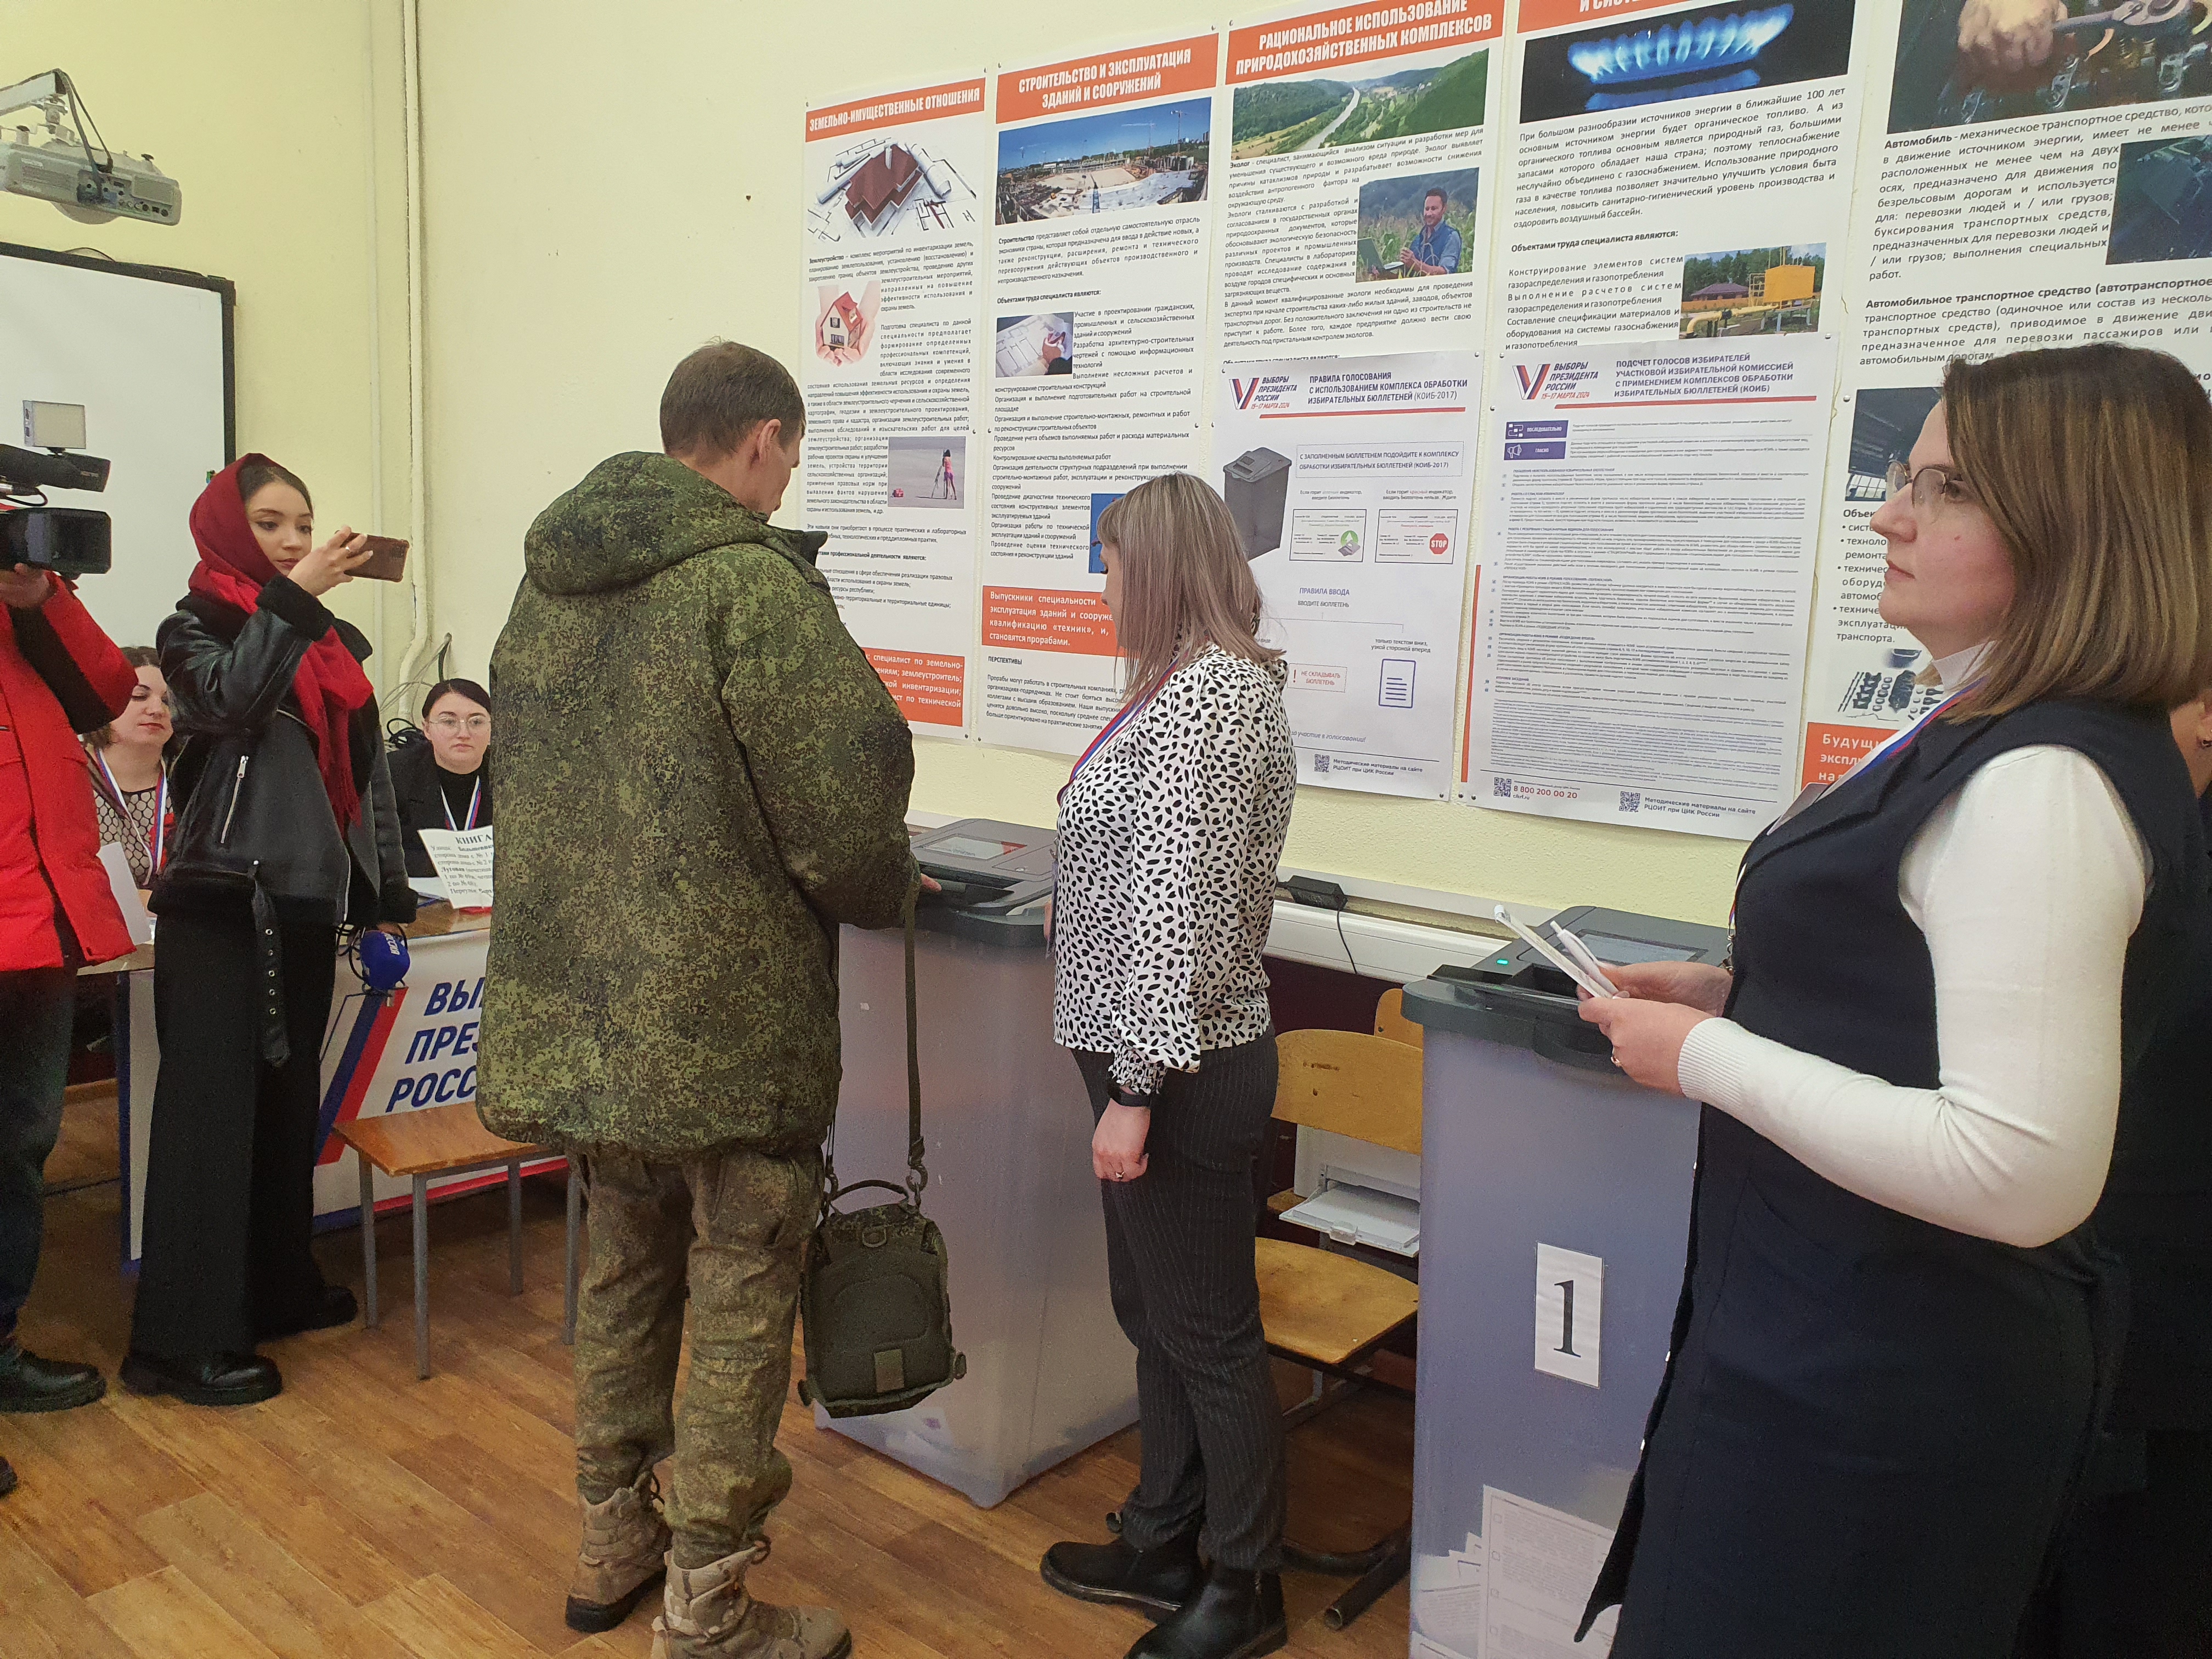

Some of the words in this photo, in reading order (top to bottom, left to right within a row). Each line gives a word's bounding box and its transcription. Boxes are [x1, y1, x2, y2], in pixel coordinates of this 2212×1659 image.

[1259, 17, 1352, 50] РАЦИОНАЛЬНОЕ
[1355, 0, 1468, 31] ИСПОЛЬЗОВАНИЕ
[1235, 31, 1398, 75] ПРИРОДОХОЗЯЙСТВЕННЫХ
[1400, 13, 1492, 46] КОМПЛЕКСОВ
[1019, 65, 1097, 93] СТРОИТЕЛЬСТВО
[1099, 63, 1107, 78] И
[1108, 48, 1191, 77] ЭКСПЛУАТАЦИЯ
[1042, 86, 1082, 110] ЗДАНИЙ
[1084, 86, 1091, 101] И
[1092, 73, 1161, 100] СООРУЖЕНИЙ
[809, 97, 924, 132] ЗЕМЕЛЬНО-ИМУЩЕСТВЕННЫЕ
[925, 88, 980, 110] ОТНОШЕНИЯ
[1520, 133, 1535, 143] При
[1538, 127, 1575, 139] большом
[1578, 118, 1637, 134] разнообразии
[1640, 110, 1691, 123] источников
[1695, 105, 1732, 116] энергии
[1746, 94, 1802, 109] ближайшие
[1807, 89, 1825, 100] 100
[1827, 88, 1846, 97] лет
[1519, 143, 1559, 154] основным
[1565, 134, 1614, 147] источником
[1621, 128, 1655, 140] энергии
[1662, 124, 1688, 134] будет
[1694, 115, 1759, 130] органическое
[1767, 108, 1809, 120] топливо.
[1816, 103, 1824, 112] А
[1832, 102, 1843, 110] из
[1516, 179, 1562, 191] неслучайно
[1565, 173, 1615, 185] объединено
[1626, 162, 1701, 178] газоснабжением.
[1705, 153, 1776, 168] Использование
[1780, 145, 1838, 160] природного
[1875, 213, 1898, 224] для:
[1905, 207, 1962, 221] перевозки
[1968, 203, 2006, 213] людей
[2041, 198, 2063, 207] или
[2071, 190, 2116, 206] грузов;
[1511, 242, 1556, 252] Объектами
[1557, 240, 1580, 250] труда
[1581, 235, 1634, 246] специалиста
[1634, 230, 1679, 241] являются:
[1908, 253, 1946, 264] грузов;
[1953, 246, 2022, 259] выполнения
[2029, 238, 2109, 253] специальных
[1869, 269, 1901, 282] работ.
[1866, 296, 1953, 308] Автомобильное
[1955, 290, 2035, 304] транспортное
[2038, 286, 2091, 299] средство
[1553, 361, 1589, 371] ВЫБОРЫ
[1616, 359, 1651, 368] ПОДСЧЕТ
[1653, 357, 1690, 366] ГОЛОСОВ
[1692, 354, 1751, 364] ИЗБИРАТЕЛЕЙ
[1549, 371, 1599, 381] ПРЕЗИДЕНТА
[1616, 366, 1667, 377] УЧАСТКОВОЙ
[1668, 365, 1737, 375] ИЗБИРАТЕЛЬНОЙ
[1739, 363, 1793, 372] КОМИССИЕЙ
[1261, 375, 1290, 384] ВЫБОРЫ
[1310, 375, 1341, 383] ПРАВИЛА
[1342, 372, 1392, 382] ГОЛОСОВАНИЯ
[1622, 377, 1682, 387] ПРИМЕНЕНИЕМ
[1683, 375, 1740, 385] КОМПЛЕКСОВ
[1742, 373, 1793, 382] ОБРАБОТКИ
[1258, 384, 1297, 393] ПРЕЗИДЕНТА
[1315, 383, 1379, 394] ИСПОЛЬЗОВАНИЕМ
[1380, 381, 1422, 391] КОМПЛЕКСА
[1424, 379, 1468, 388] ОБРАБОТКИ
[1544, 382, 1577, 391] РОССИИ
[1614, 388, 1682, 397] ИЗБИРАТЕЛЬНЫХ
[1684, 384, 1739, 394] БЮЛЛЕТЕНЕЙ
[1740, 385, 1770, 394] (КОИБ)
[1308, 395, 1365, 405] ИЗБИРАТЕЛЬНЫХ
[1367, 392, 1413, 402] БЮЛЛЕТЕНЕЙ
[1414, 391, 1457, 402] (КОИБ-2017)
[1431, 540, 1447, 548] STOP
[1842, 578, 1885, 588] оборуд
[990, 591, 1033, 602] Выпускники
[1038, 596, 1096, 606] специальности
[1329, 588, 1350, 596] ВВОДА
[990, 606, 1036, 617] эксплуатация
[1040, 608, 1067, 618] зданий
[990, 619, 1047, 631] квалификацию
[1053, 624, 1094, 635] «техник»,
[1101, 628, 1109, 636] и,
[989, 633, 1026, 642] становятся
[1026, 635, 1070, 646] прорабами.
[1837, 633, 1895, 643] транспорта.
[873, 654, 911, 664] специалист
[927, 659, 963, 669] земельно-
[988, 656, 1022, 665] ПЕРСПЕКТИВЫ
[902, 683, 961, 696] инвентаризации;
[918, 697, 961, 707] технической
[1820, 754, 1861, 765] экспл
[1520, 786, 1534, 794] 800
[1536, 788, 1551, 796] 200
[424, 977, 486, 1016] ВЫ
[405, 1022, 479, 1064] ПРЕ
[1554, 1279, 1581, 1358] 1
